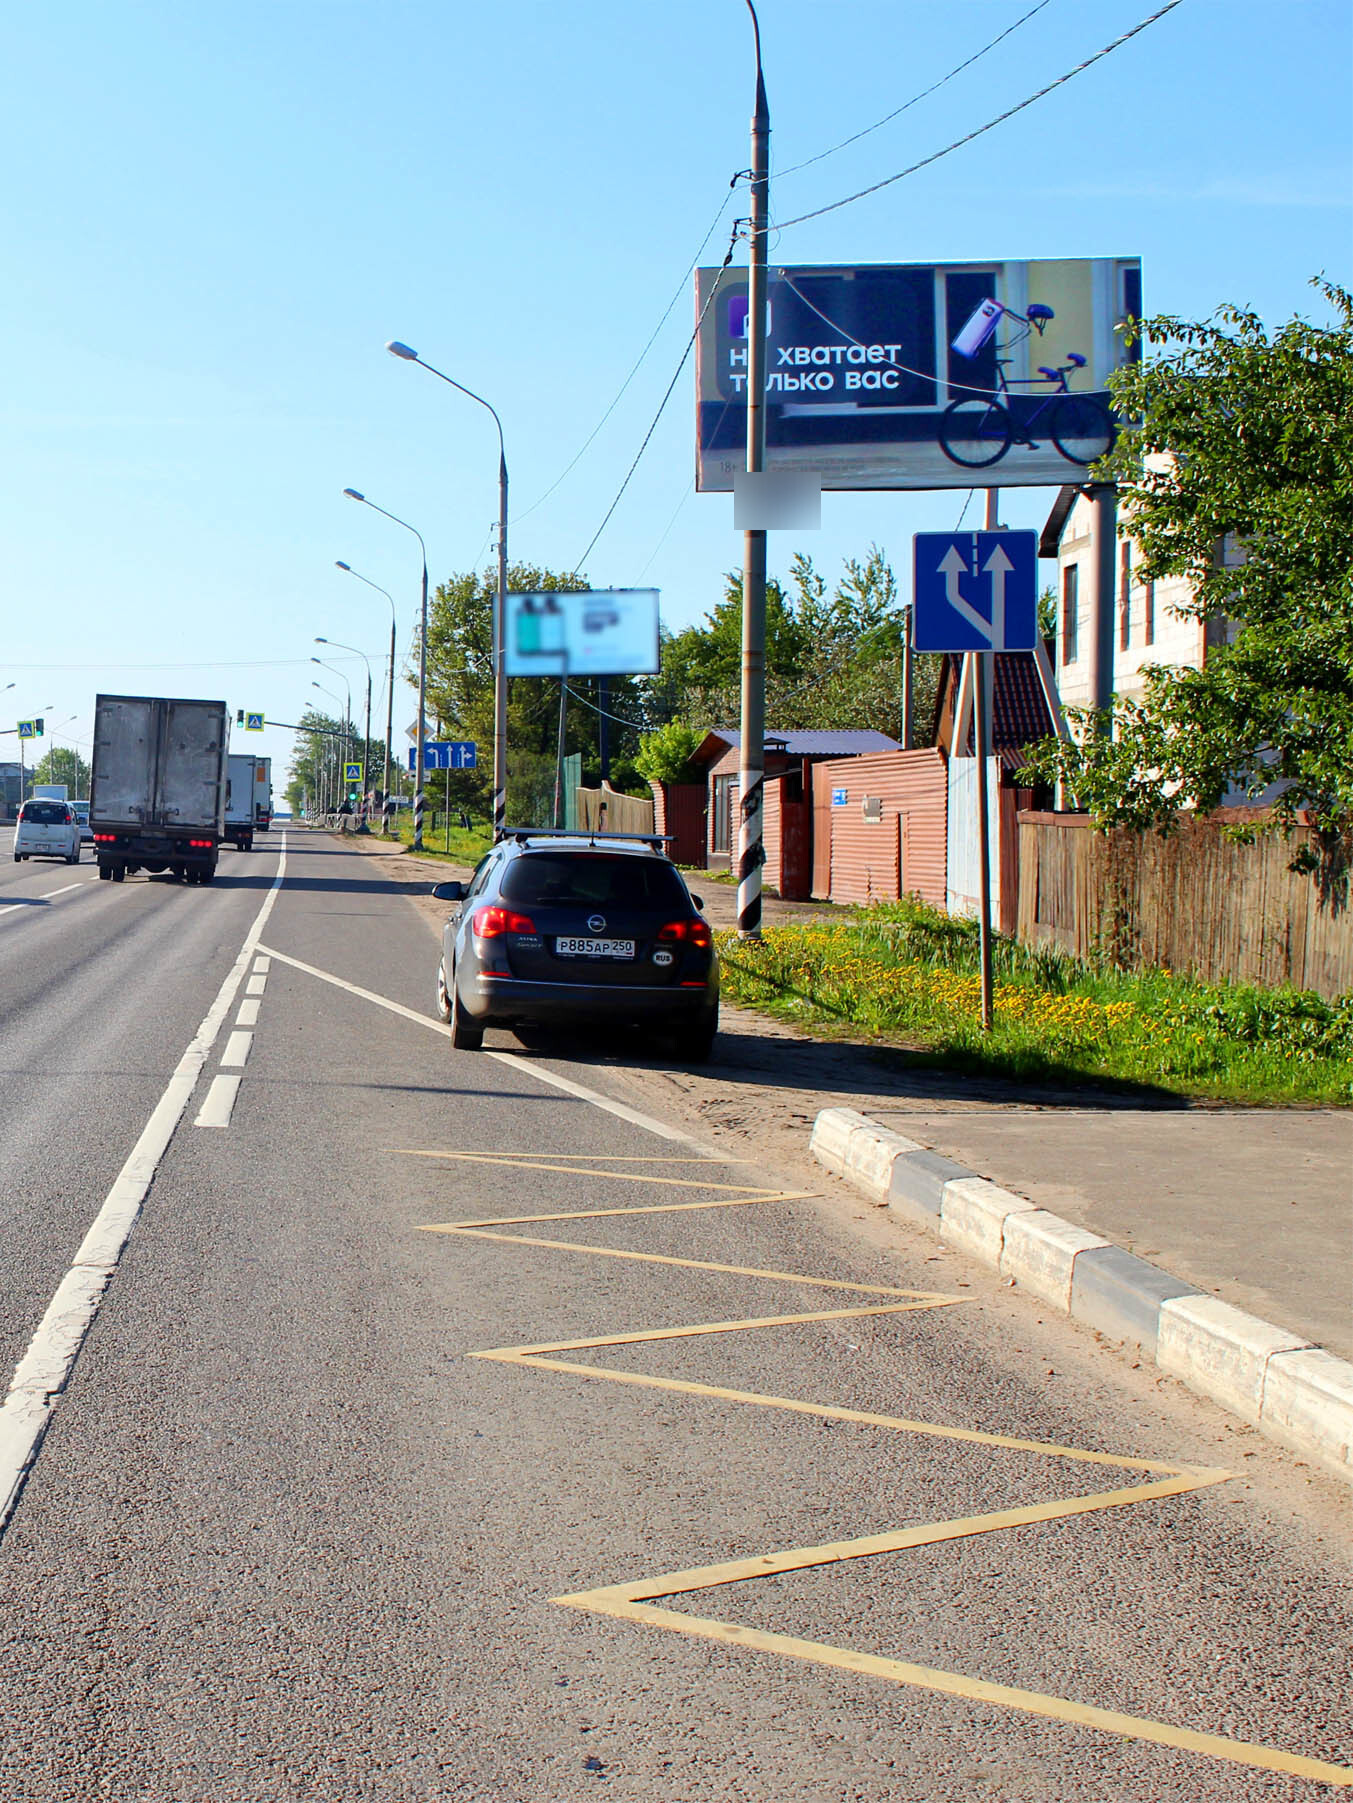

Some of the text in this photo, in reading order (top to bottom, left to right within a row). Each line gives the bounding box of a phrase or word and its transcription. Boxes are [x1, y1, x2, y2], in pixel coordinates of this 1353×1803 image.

[777, 345, 902, 366] хватает
[729, 369, 900, 392] тлько вас
